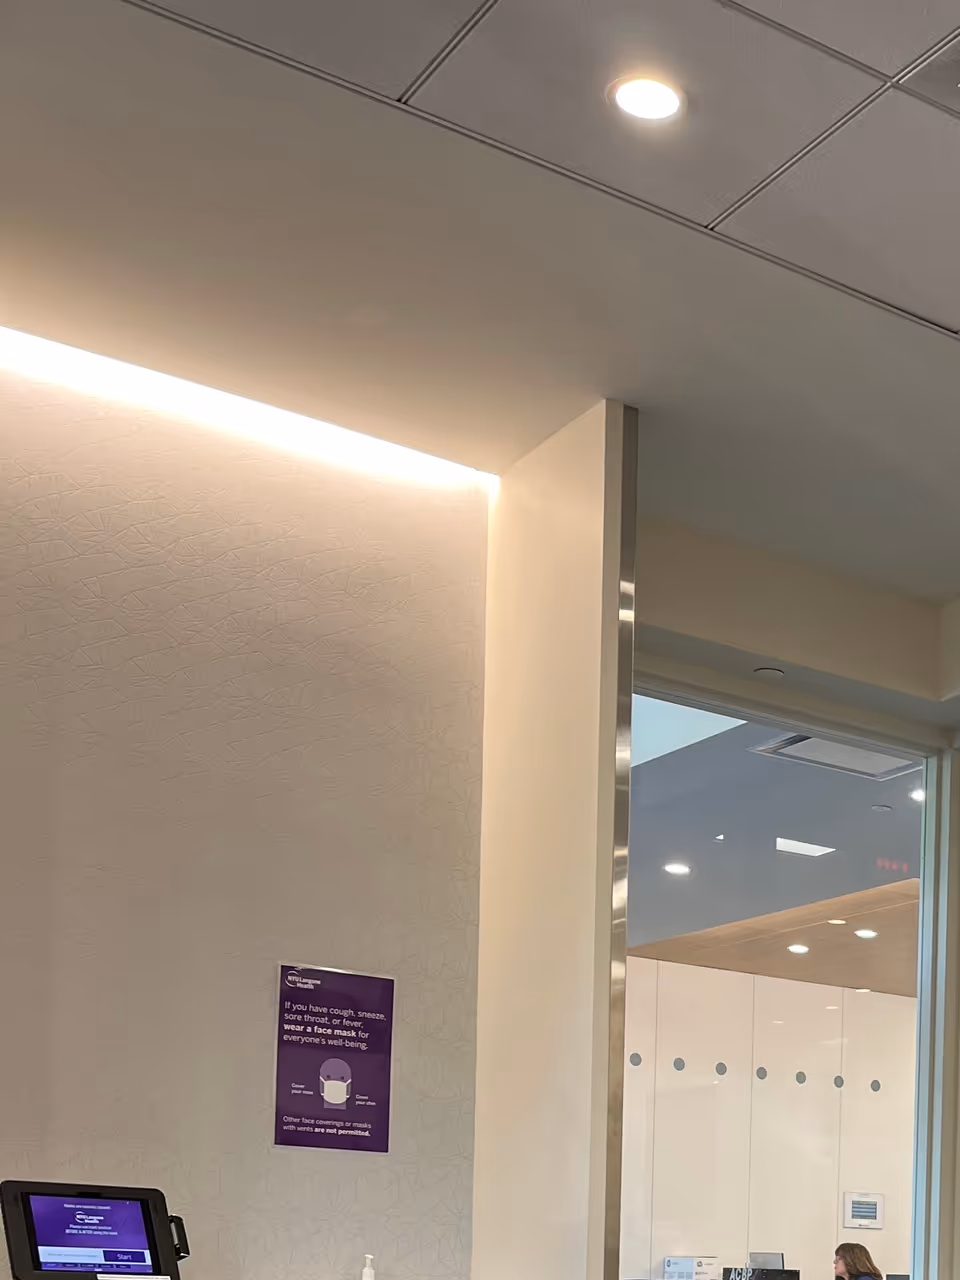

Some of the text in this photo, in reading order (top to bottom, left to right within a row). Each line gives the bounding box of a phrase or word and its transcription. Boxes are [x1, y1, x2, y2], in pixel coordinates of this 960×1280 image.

[284, 1001, 291, 1009] If
[292, 1003, 308, 1012] you
[308, 1004, 328, 1014] have
[284, 1013, 302, 1021] sore
[283, 1023, 305, 1032] wear
[313, 1025, 332, 1035] face
[334, 1028, 357, 1037] mask
[358, 1030, 370, 1039] for
[283, 1034, 326, 1044] everyone's
[283, 1115, 301, 1123] Other
[302, 1117, 315, 1125] face
[315, 1119, 344, 1128] coverings
[352, 1121, 372, 1129] masks
[117, 1253, 133, 1261] Start
[729, 1268, 753, 1280] ACBP
